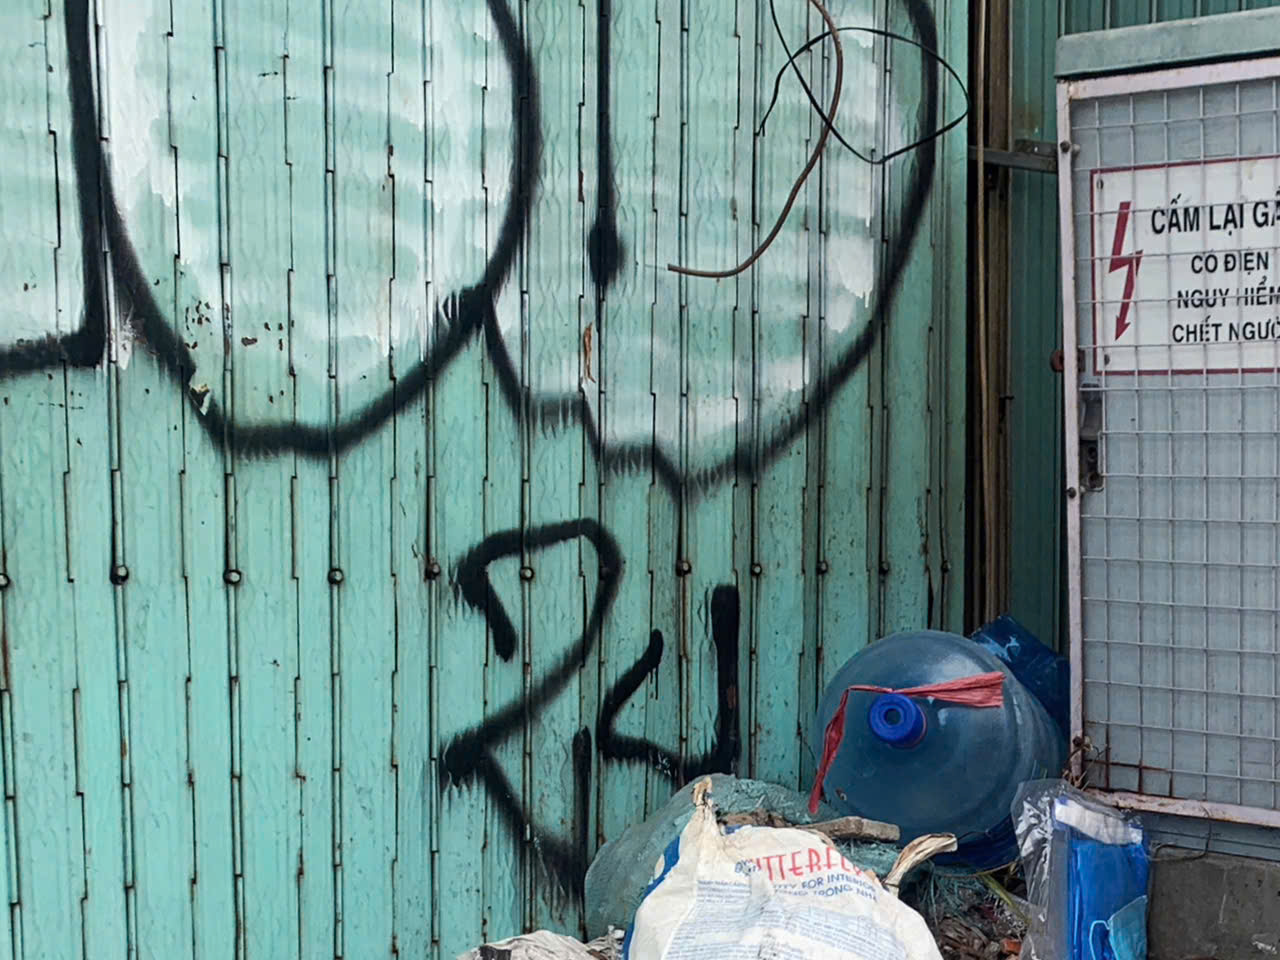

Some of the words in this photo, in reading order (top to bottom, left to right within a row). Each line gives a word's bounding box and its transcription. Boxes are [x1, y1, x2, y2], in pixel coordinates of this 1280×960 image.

[1151, 193, 1200, 234] CẤM
[1209, 203, 1244, 236] LẠI
[1177, 288, 1230, 309] NGUY
[1172, 315, 1222, 343] CHẾT
[802, 876, 824, 890] FOR
